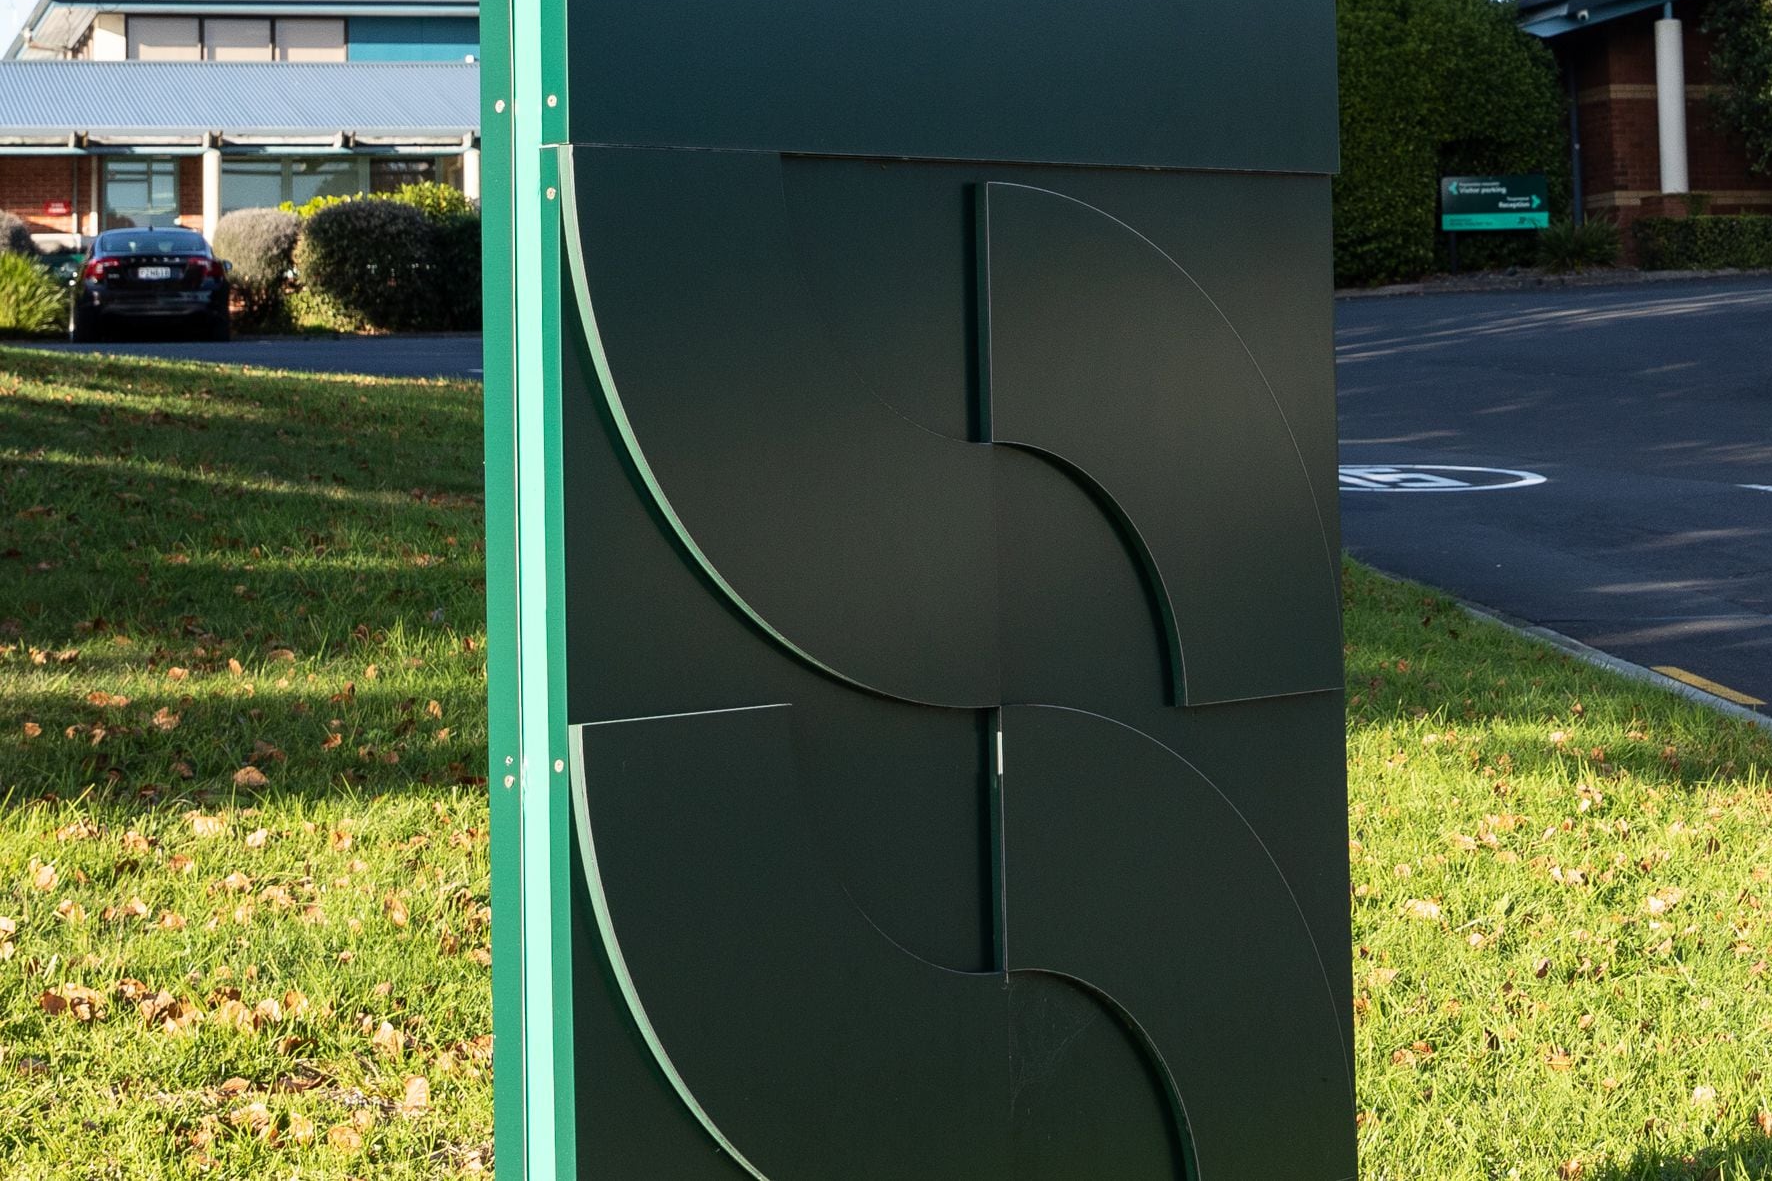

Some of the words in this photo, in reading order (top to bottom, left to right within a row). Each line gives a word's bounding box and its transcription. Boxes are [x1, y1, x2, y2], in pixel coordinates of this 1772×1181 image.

[1459, 186, 1480, 194] Visitor
[1481, 186, 1507, 195] parking
[1498, 201, 1531, 210] Reception
